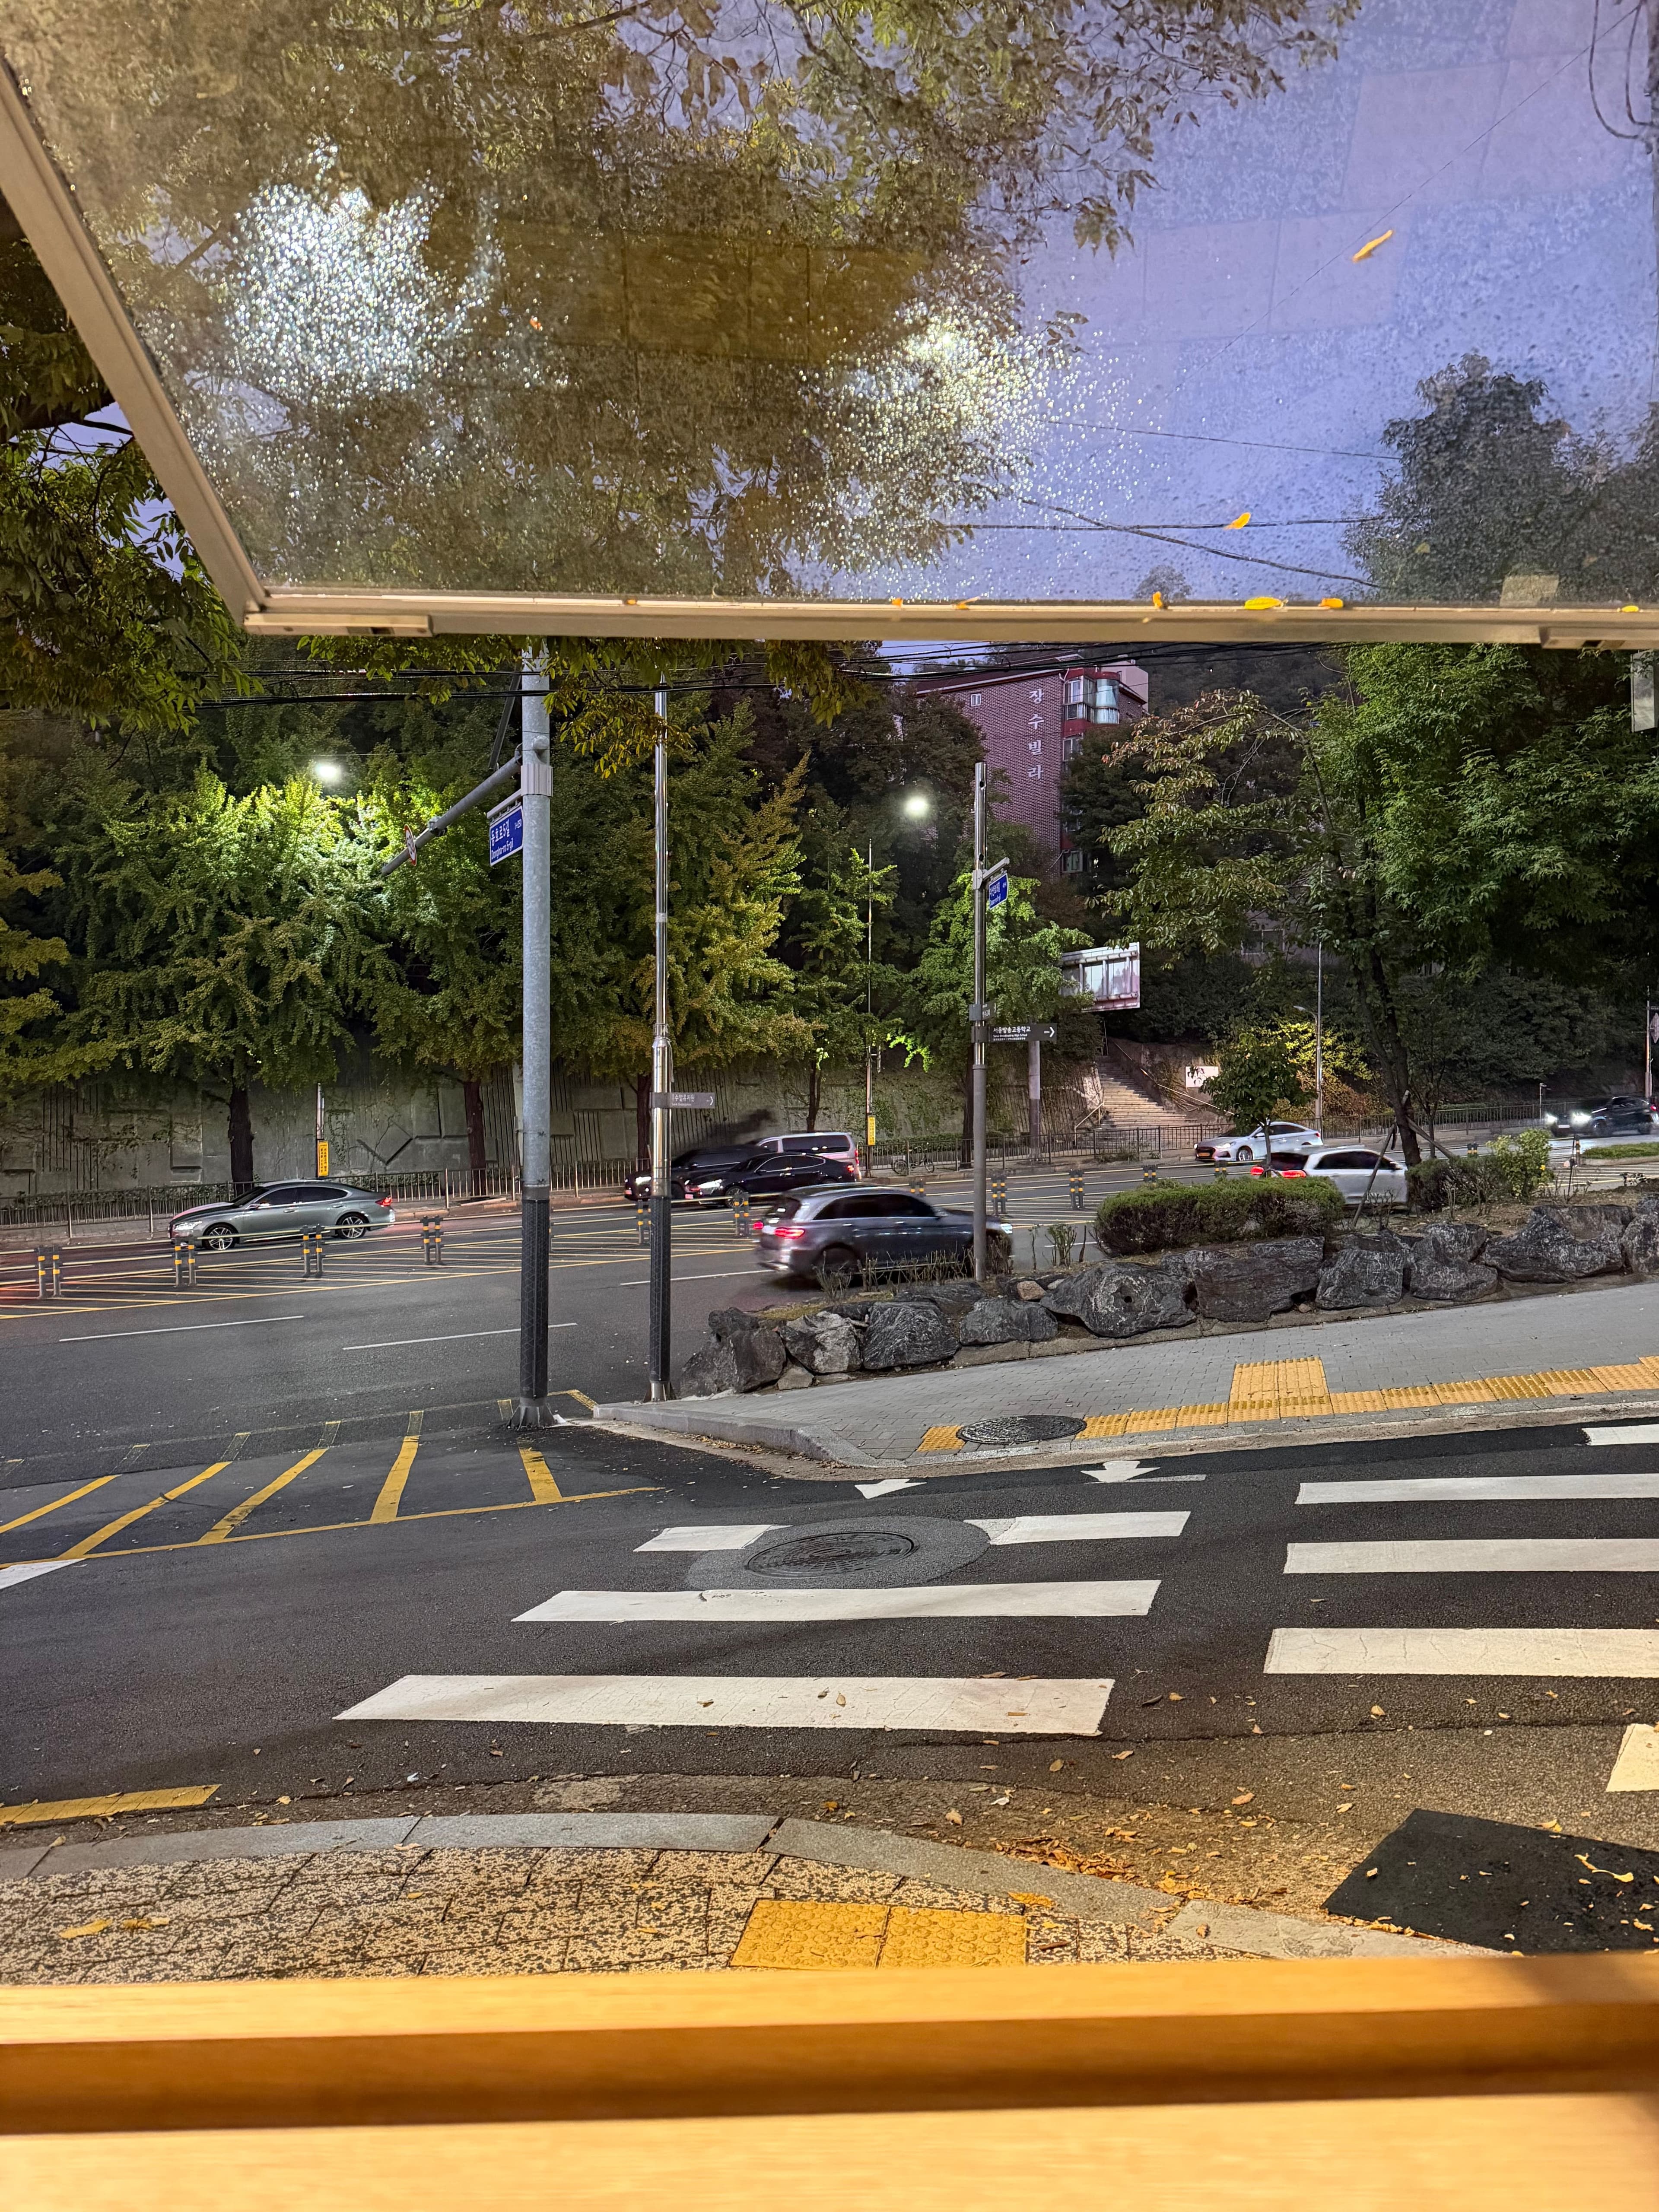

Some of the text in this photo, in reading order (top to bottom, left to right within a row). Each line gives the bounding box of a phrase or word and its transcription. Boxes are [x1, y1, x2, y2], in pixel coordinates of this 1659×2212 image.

[1027, 688, 1045, 779] 장수빌라
[491, 819, 510, 847] 동호로5길
[993, 1026, 1031, 1034] 서울방송고등학교
